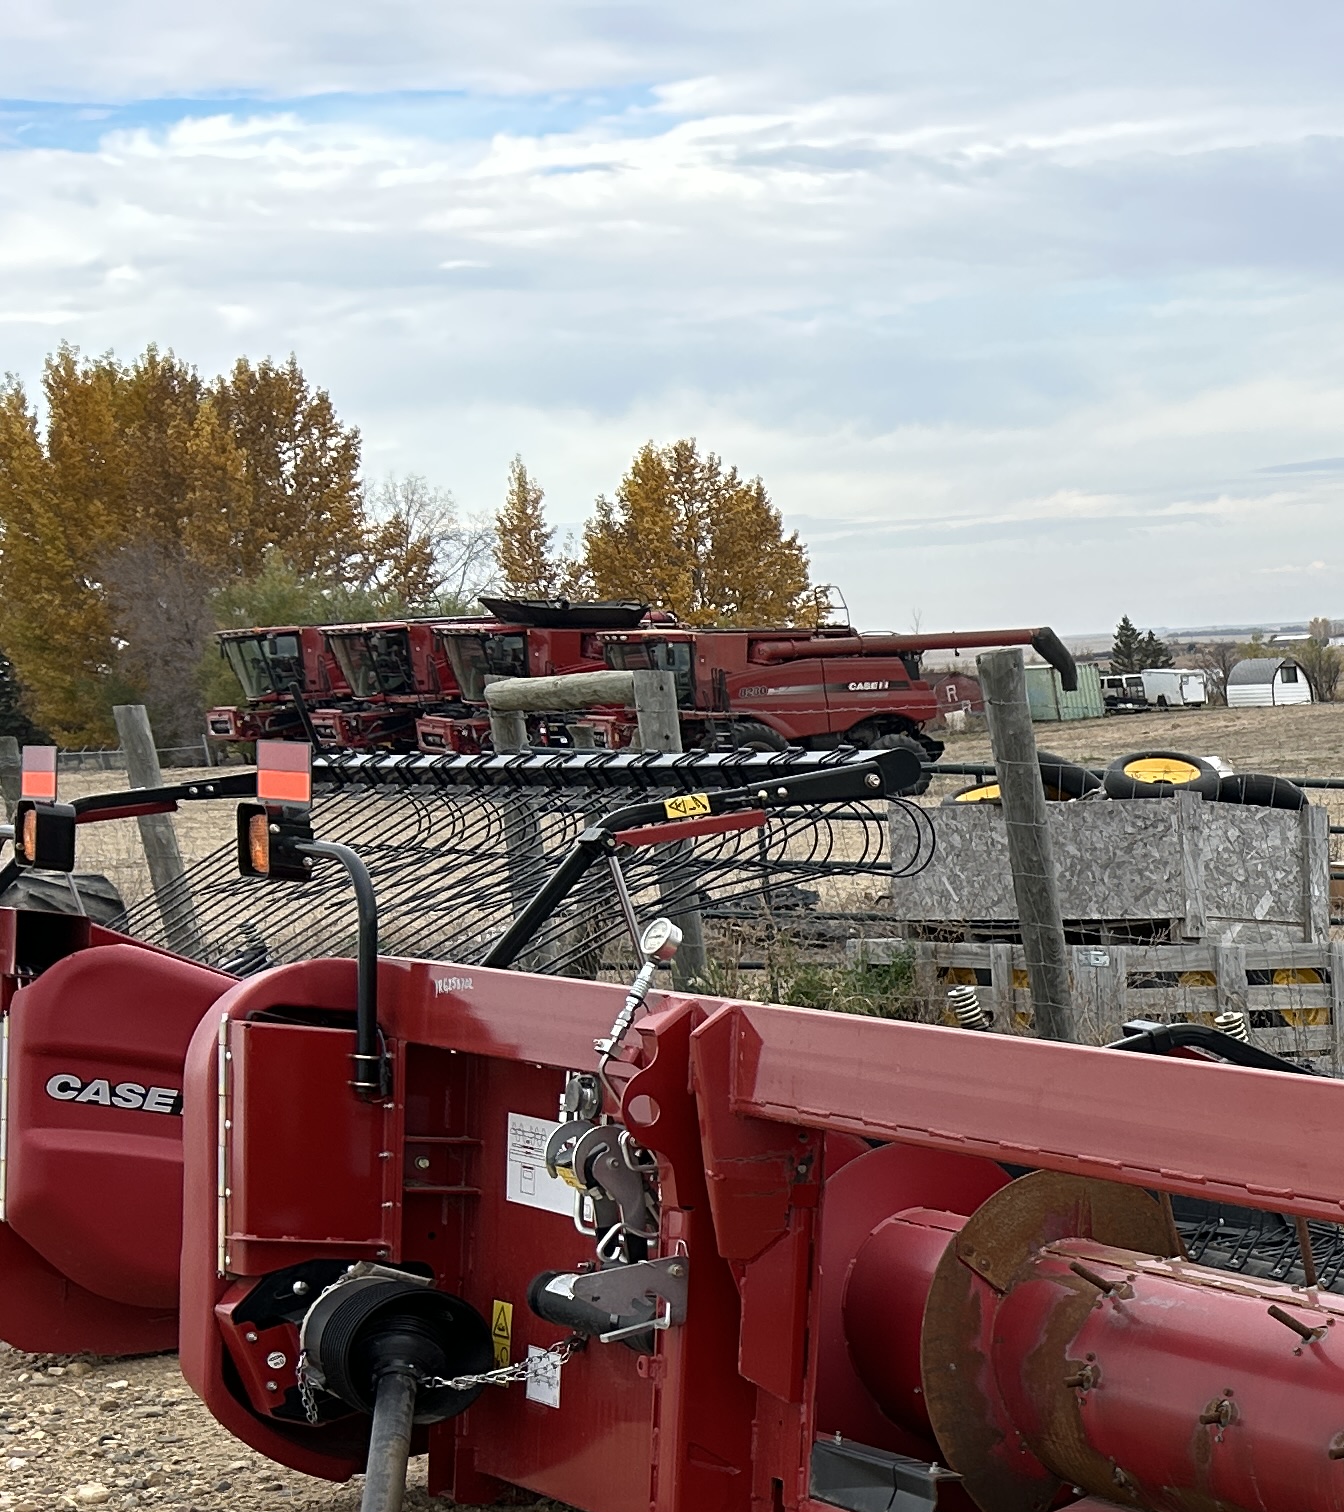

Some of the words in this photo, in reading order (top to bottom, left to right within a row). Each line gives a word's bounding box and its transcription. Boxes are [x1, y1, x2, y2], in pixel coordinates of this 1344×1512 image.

[848, 681, 878, 691] CASE
[946, 684, 958, 703] R
[46, 1074, 179, 1113] CASE
